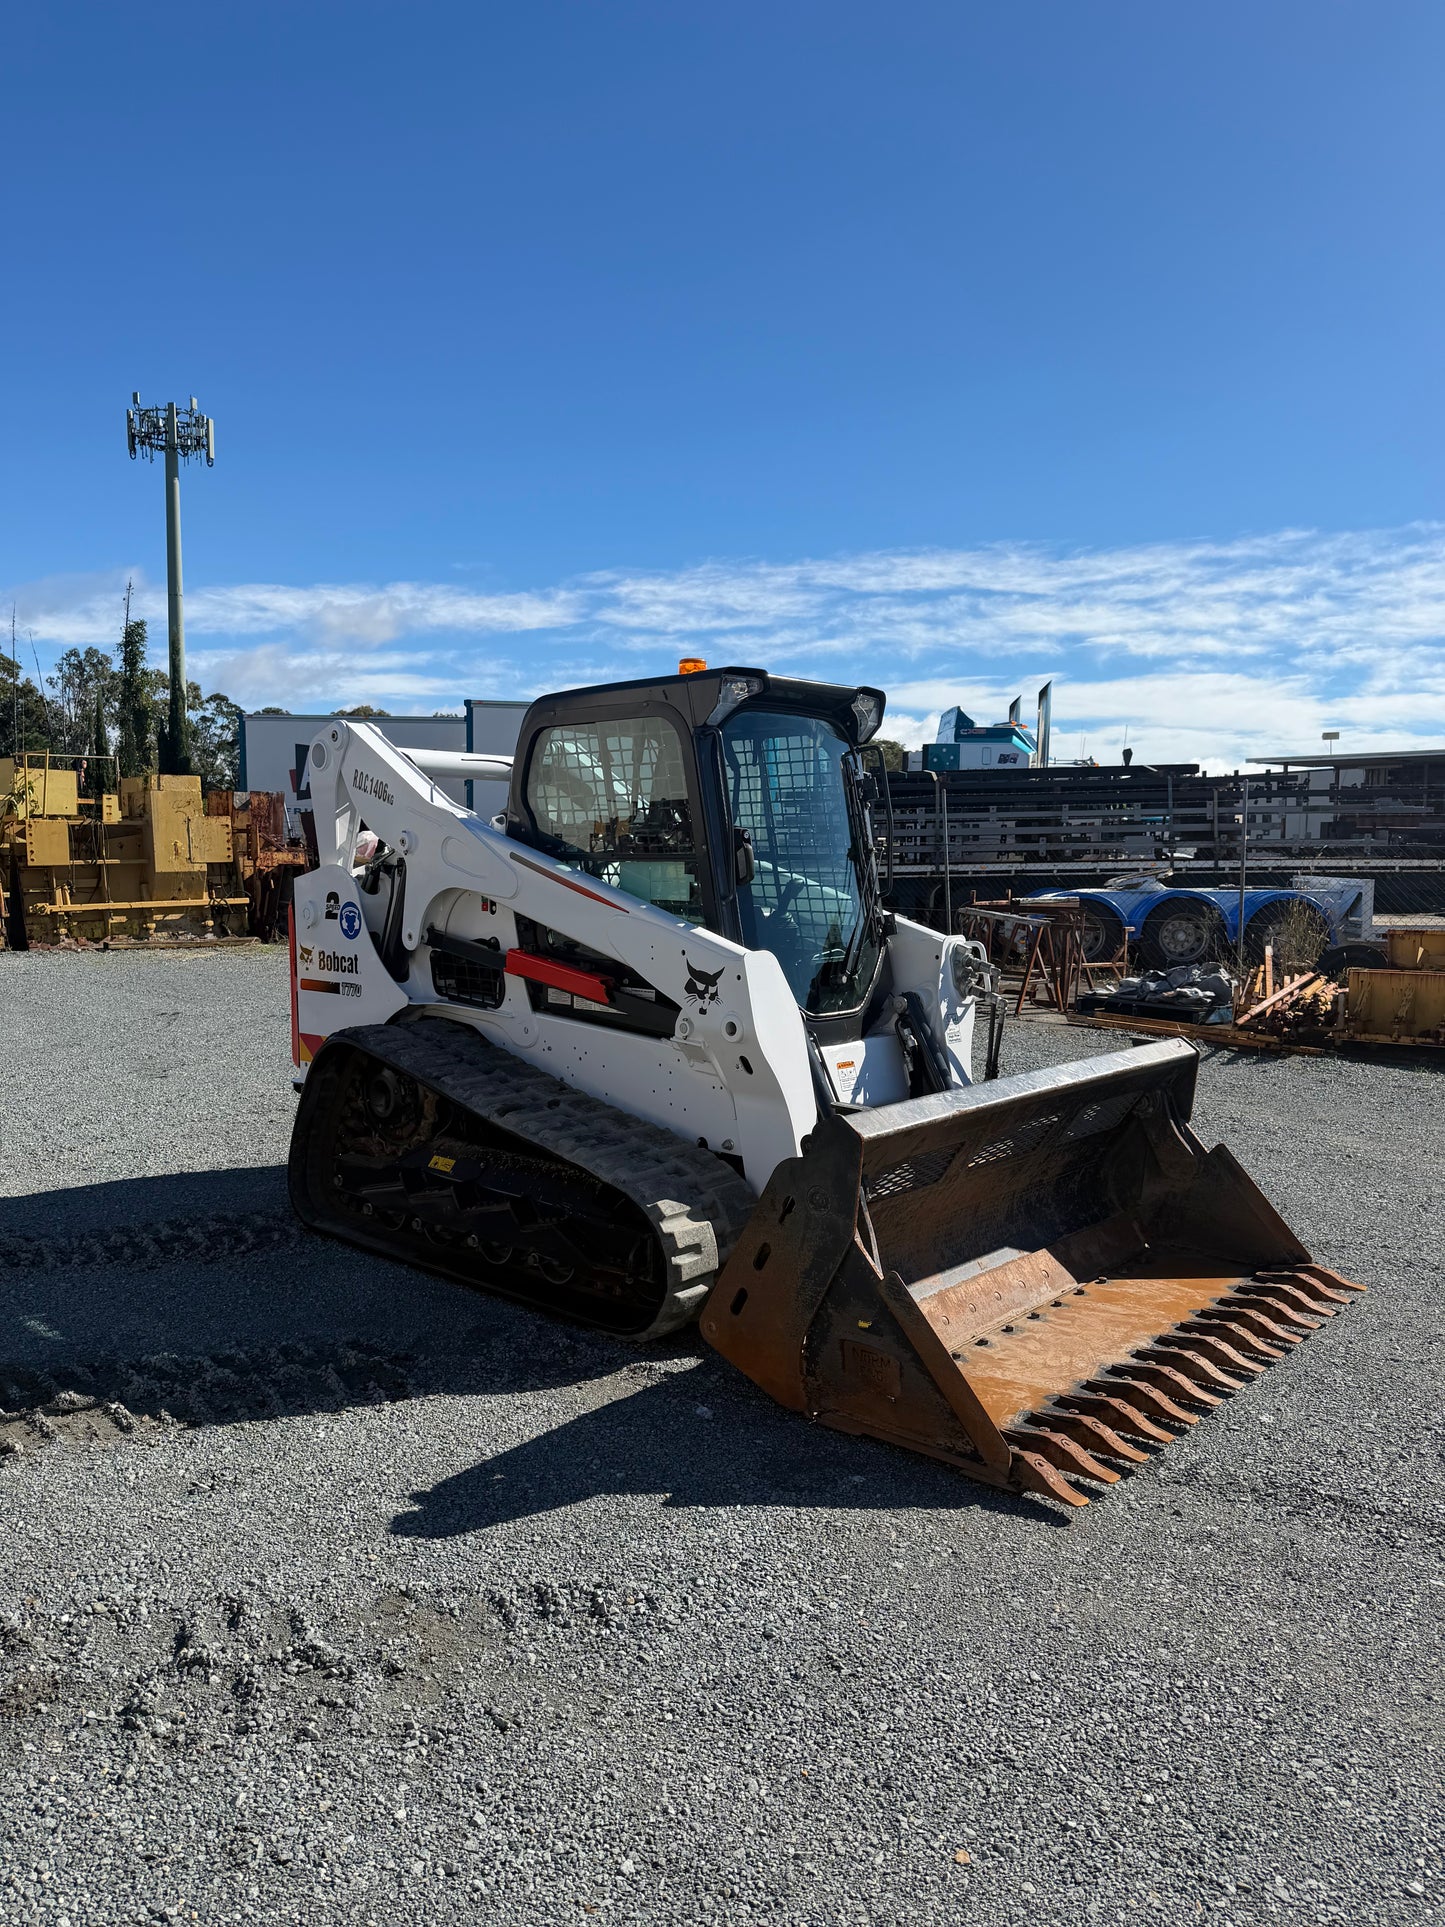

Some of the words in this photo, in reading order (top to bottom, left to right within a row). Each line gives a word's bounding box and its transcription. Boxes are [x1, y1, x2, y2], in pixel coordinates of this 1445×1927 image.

[325, 891, 340, 920] 2
[318, 950, 359, 975] Bobcat
[341, 981, 362, 997] T770
